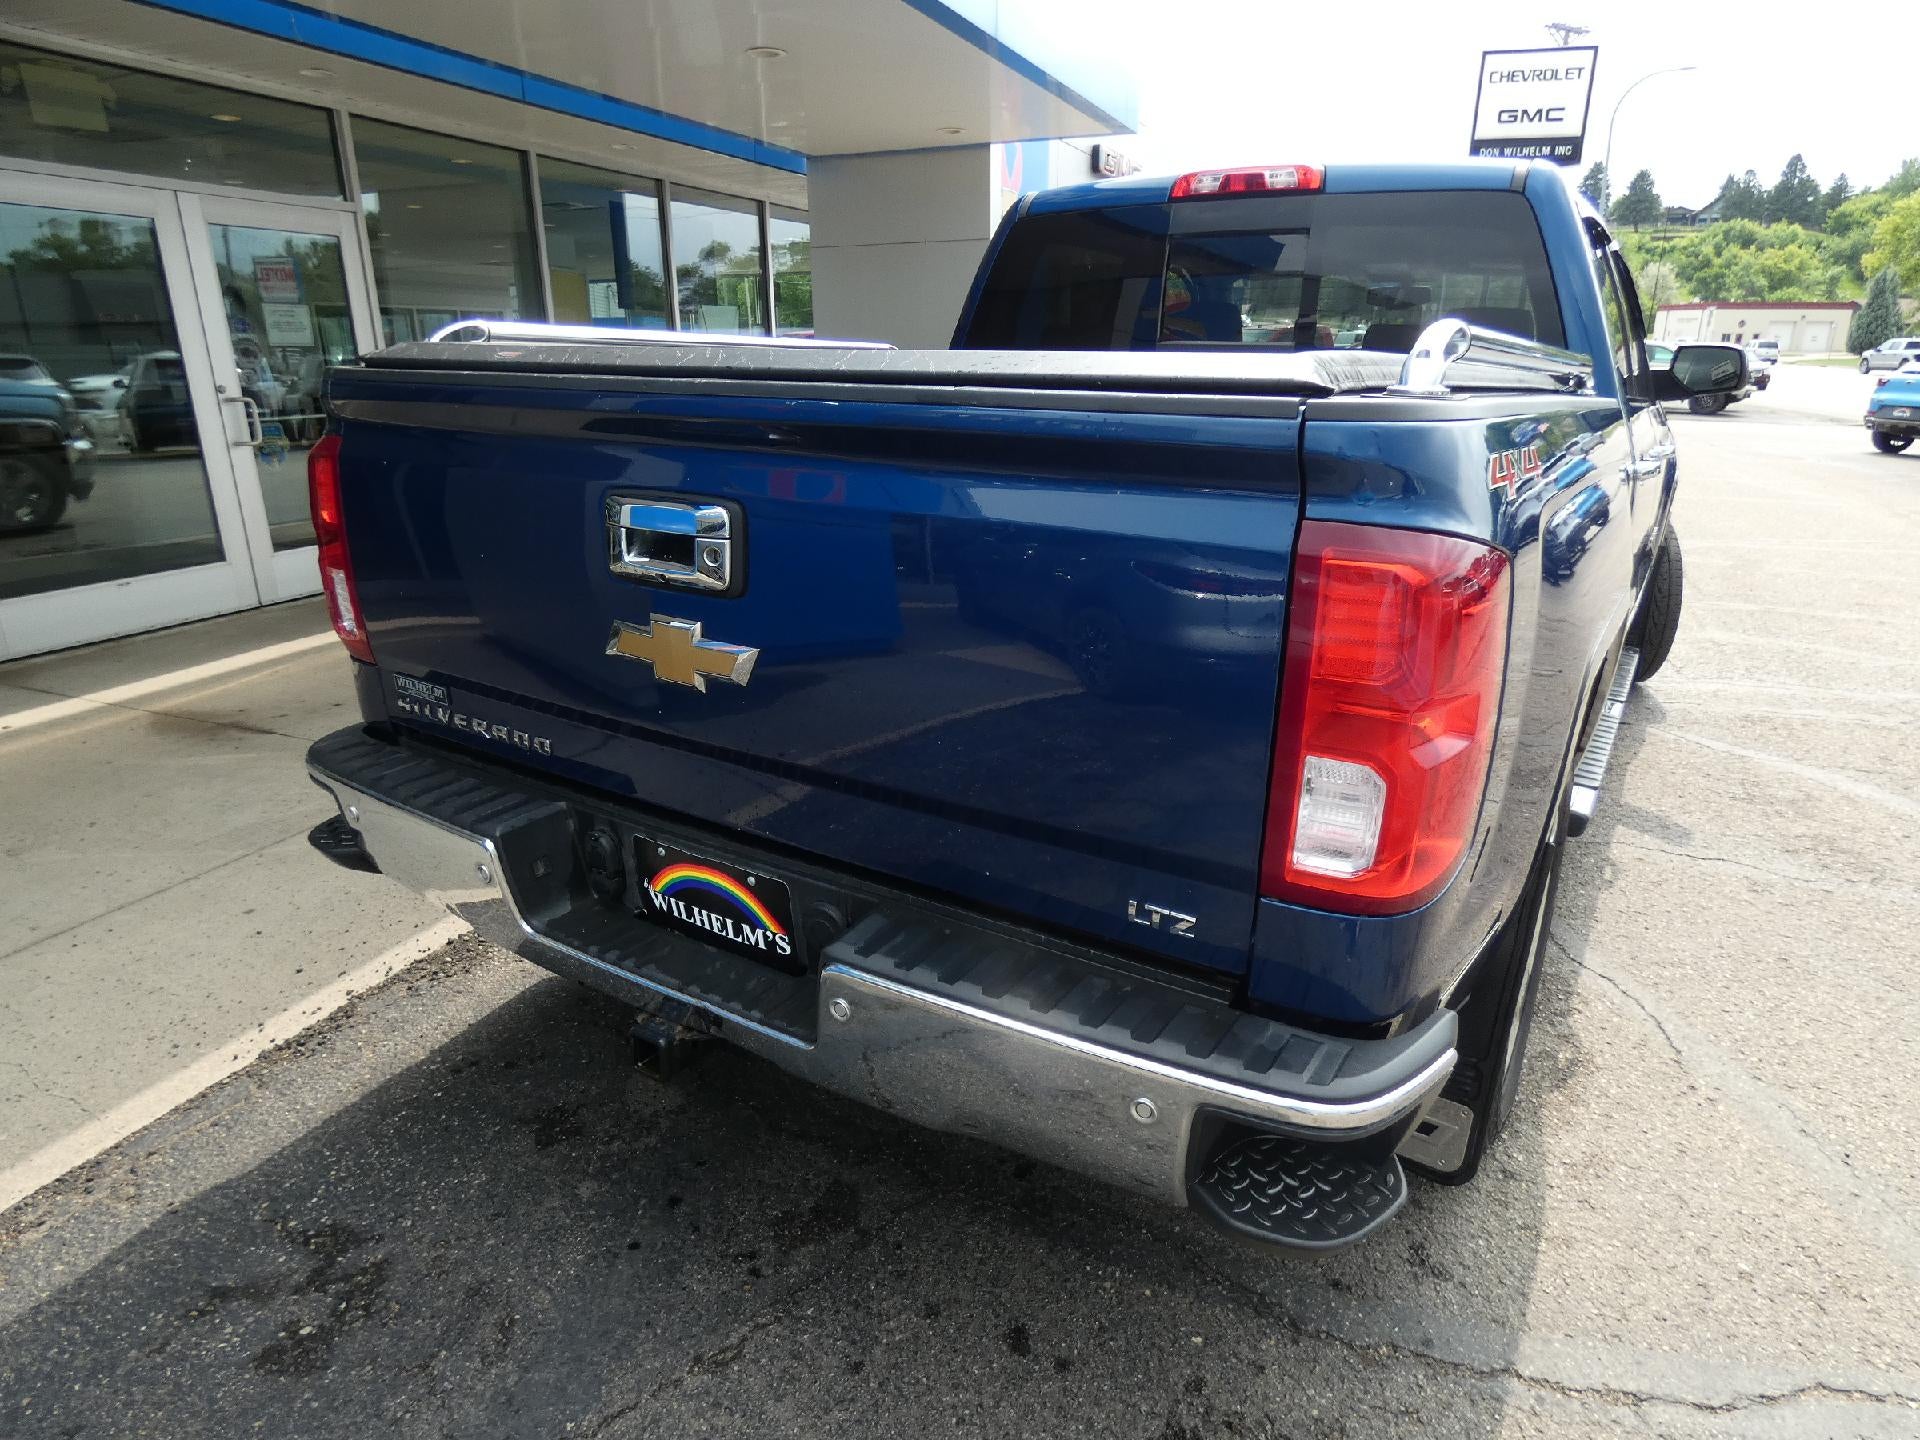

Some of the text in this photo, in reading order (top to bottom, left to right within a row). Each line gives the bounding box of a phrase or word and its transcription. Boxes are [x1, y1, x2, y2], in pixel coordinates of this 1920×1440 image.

[1489, 66, 1585, 84] CHEVROLET
[1497, 107, 1565, 124] GMC
[1479, 145, 1573, 157] DON WILHELM INC
[397, 696, 553, 757] SILVERADO
[649, 888, 792, 956] WILHELM'S
[1127, 899, 1197, 938] LTZ
